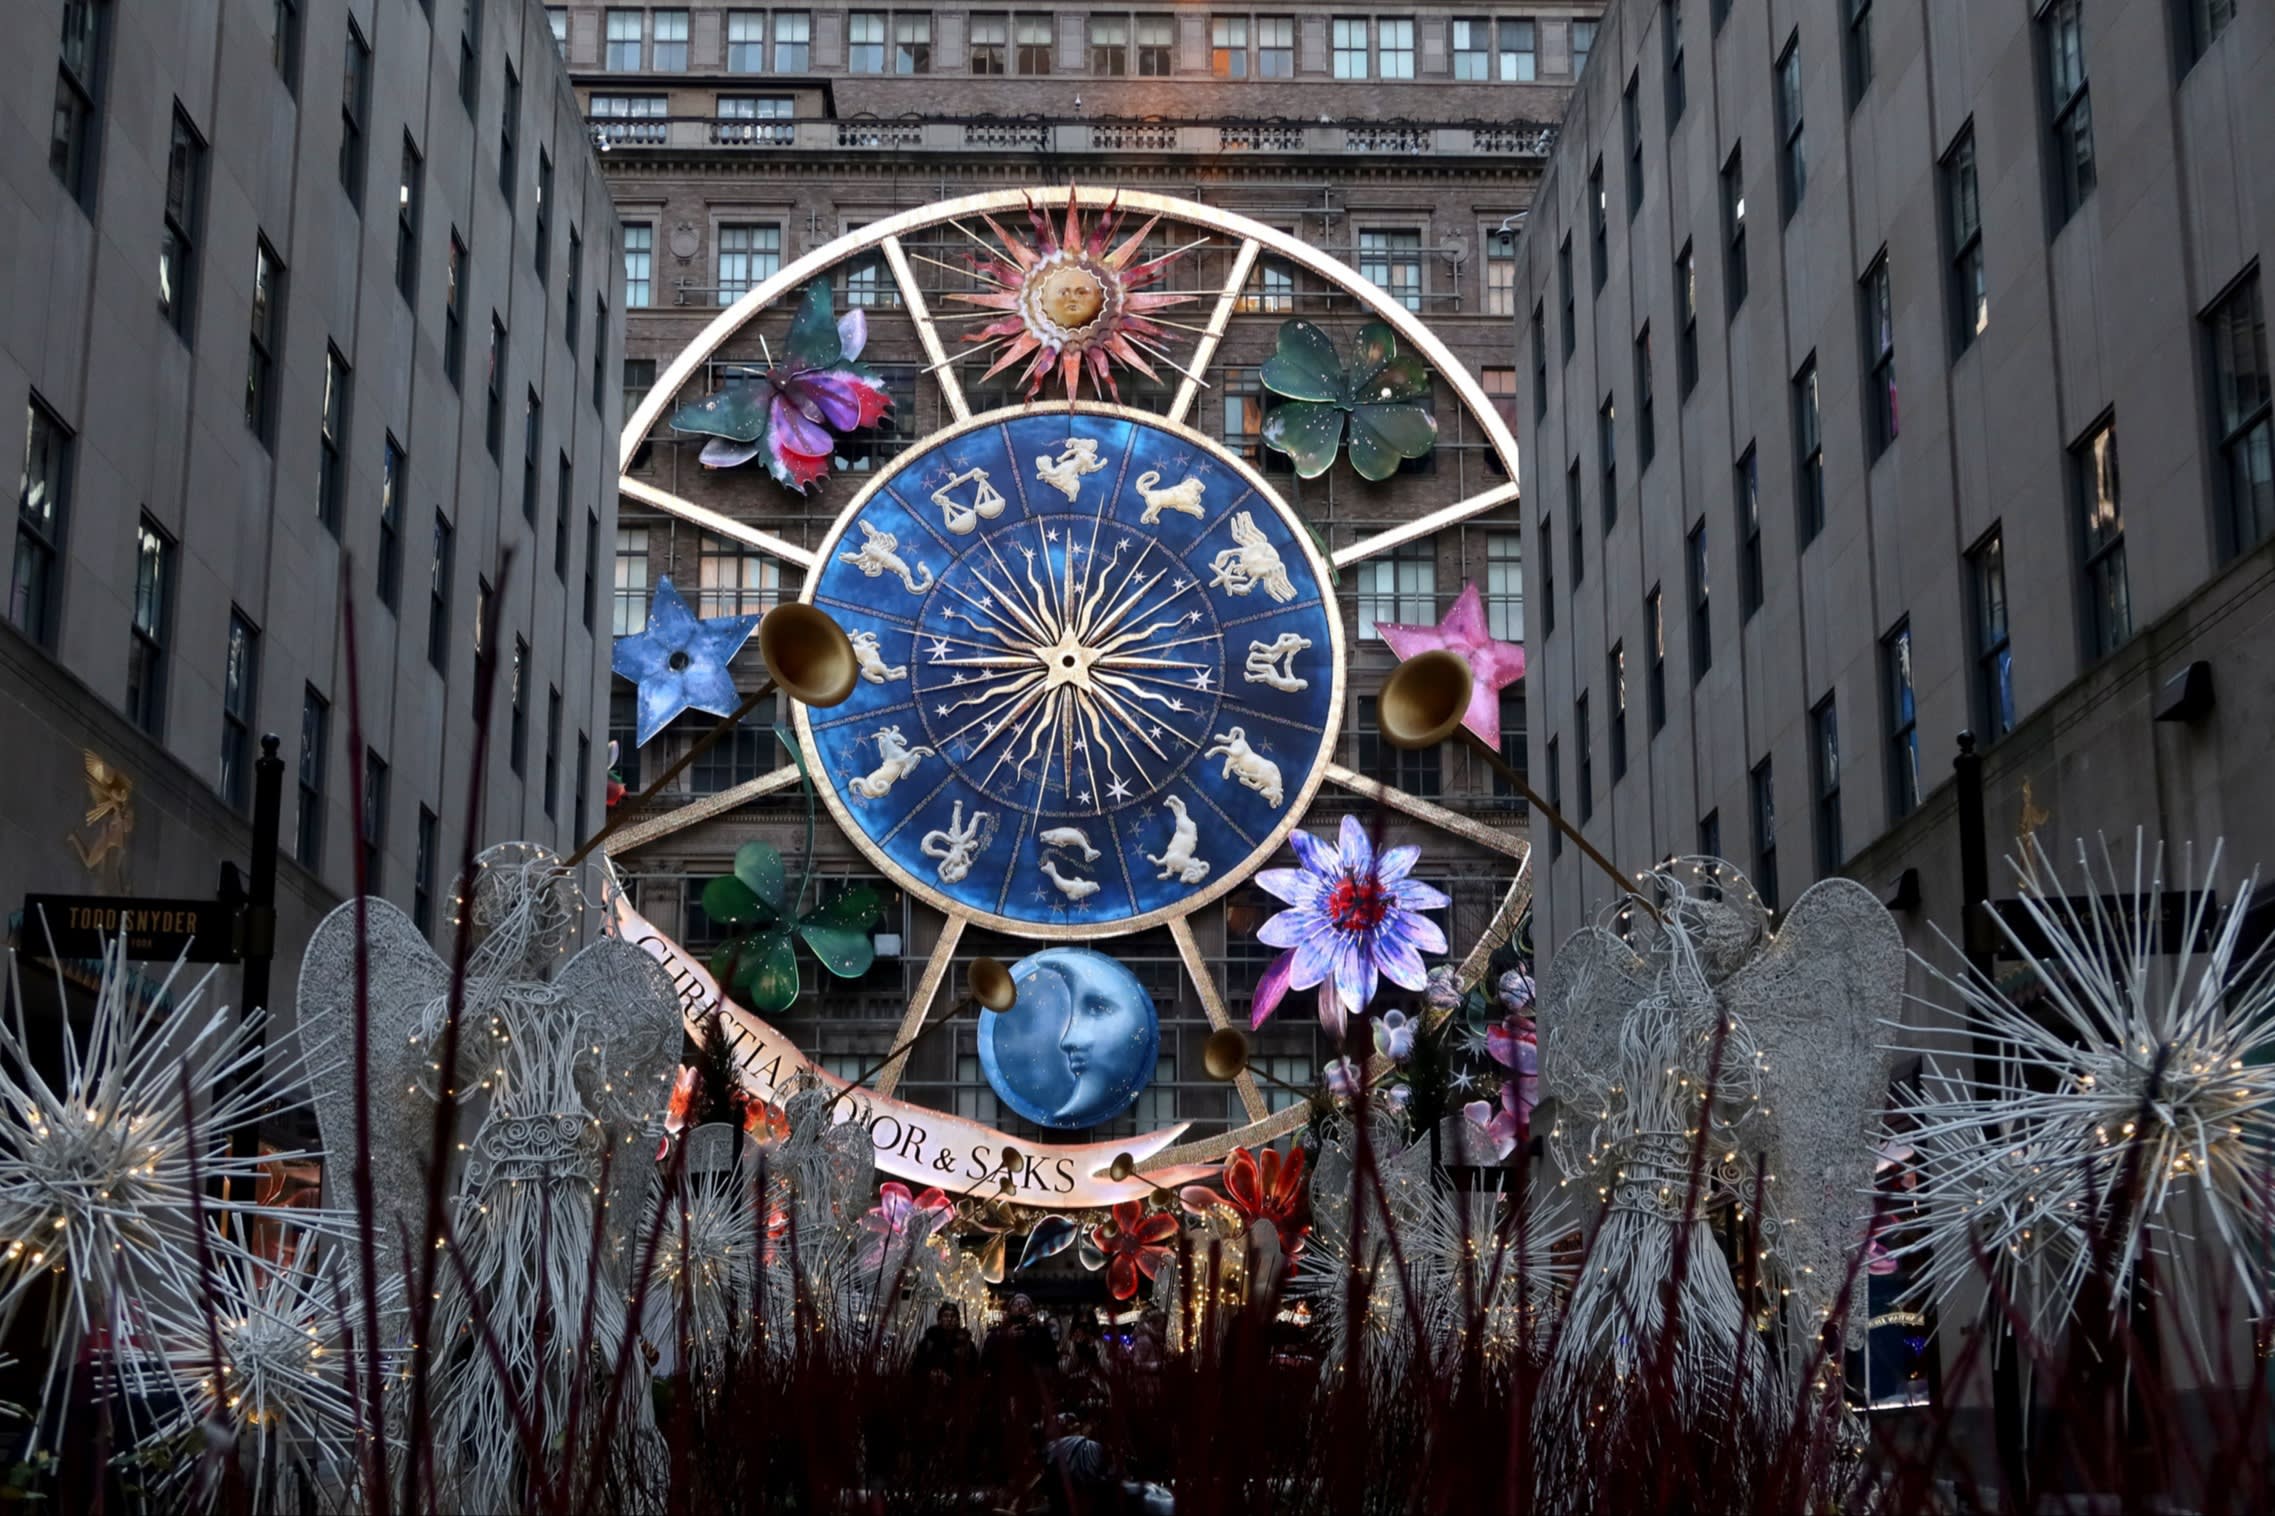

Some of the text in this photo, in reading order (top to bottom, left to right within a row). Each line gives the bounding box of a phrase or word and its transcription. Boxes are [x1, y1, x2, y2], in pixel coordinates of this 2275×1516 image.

[69, 906, 197, 934] TODD SNYDER
[932, 1148, 957, 1173] &
